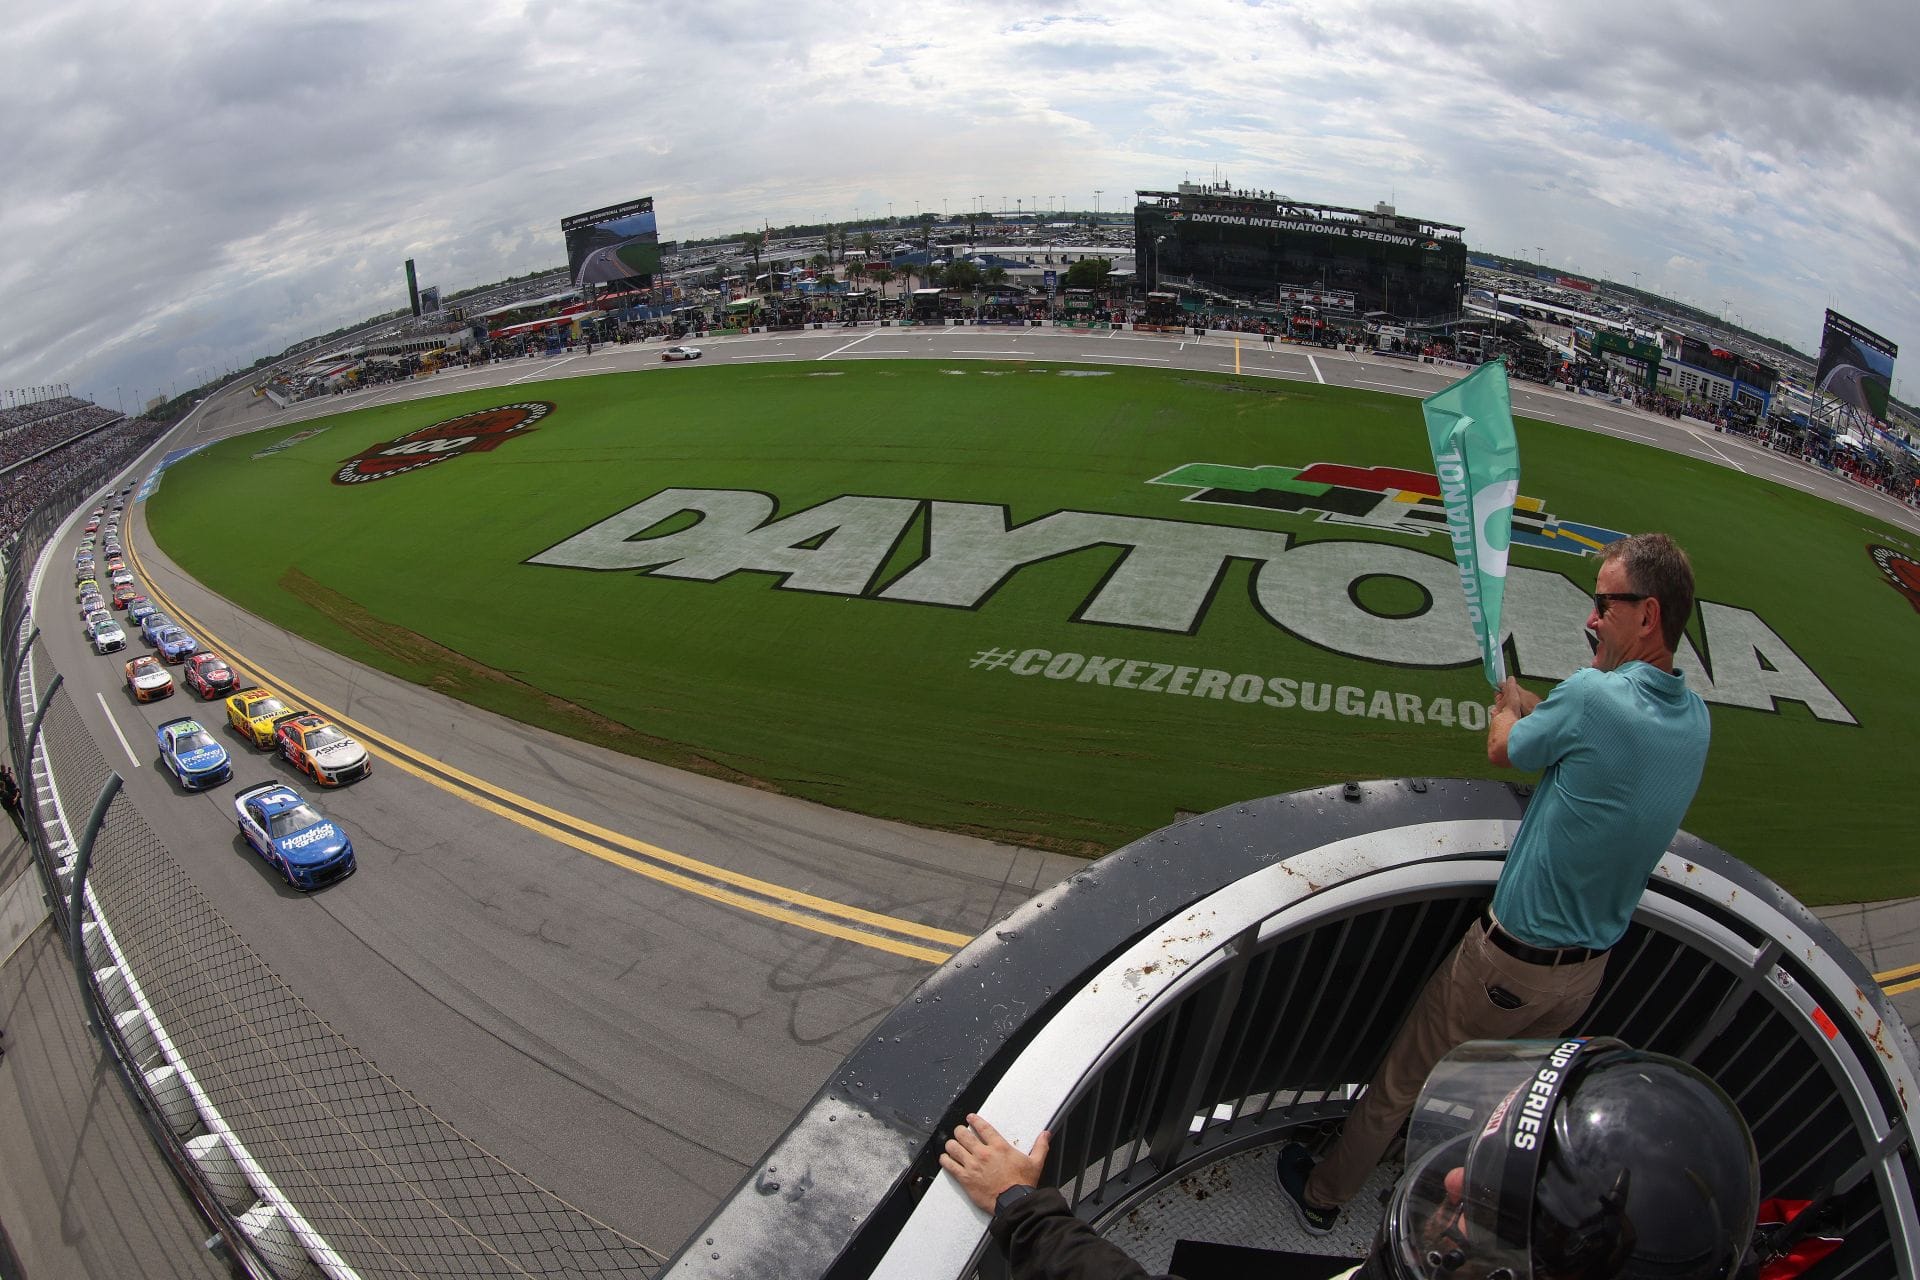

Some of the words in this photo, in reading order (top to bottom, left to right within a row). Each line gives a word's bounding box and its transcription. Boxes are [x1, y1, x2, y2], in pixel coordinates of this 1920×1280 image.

[1191, 212, 1246, 226] DAYTONA
[1249, 217, 1349, 237] INTERNATIONAL
[1351, 229, 1417, 247] SPEEDWAY
[968, 646, 1497, 732] #COKEZEROSUGAR40
[281, 823, 333, 850] Hendrick
[1550, 1042, 1580, 1068] CUP
[1514, 1068, 1560, 1151] SERIES
